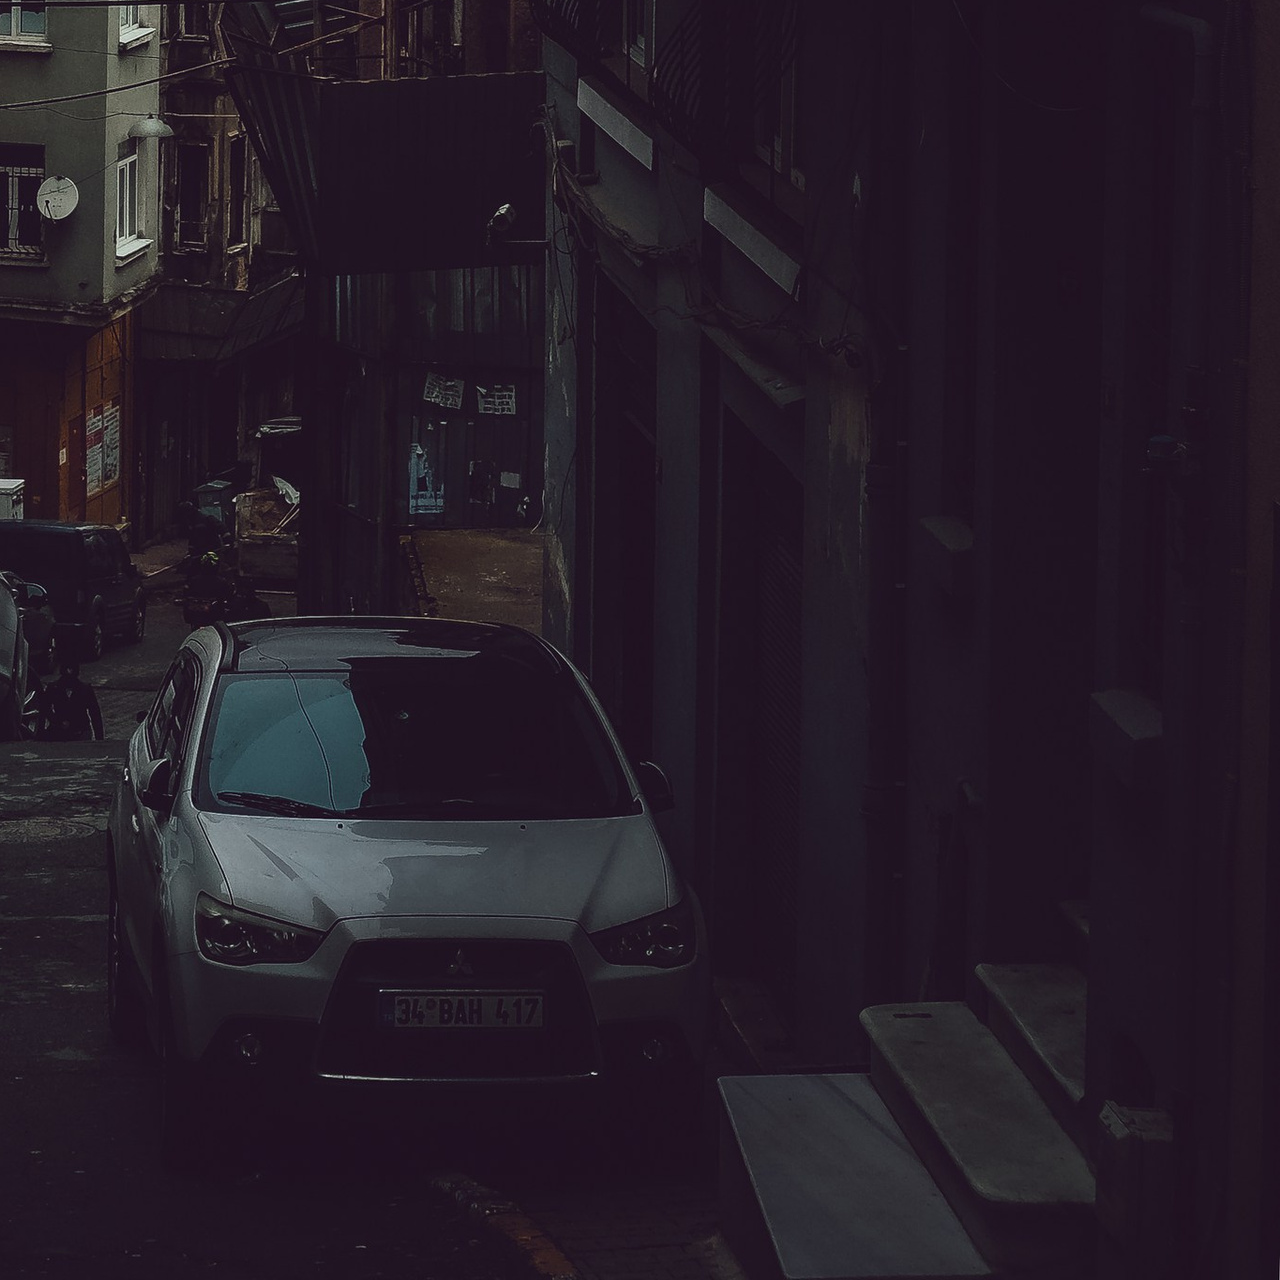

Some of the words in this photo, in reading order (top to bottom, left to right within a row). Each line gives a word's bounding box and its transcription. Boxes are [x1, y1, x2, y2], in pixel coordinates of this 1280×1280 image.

[396, 998, 425, 1024] 34
[439, 998, 483, 1024] BAH
[495, 998, 540, 1024] 417
